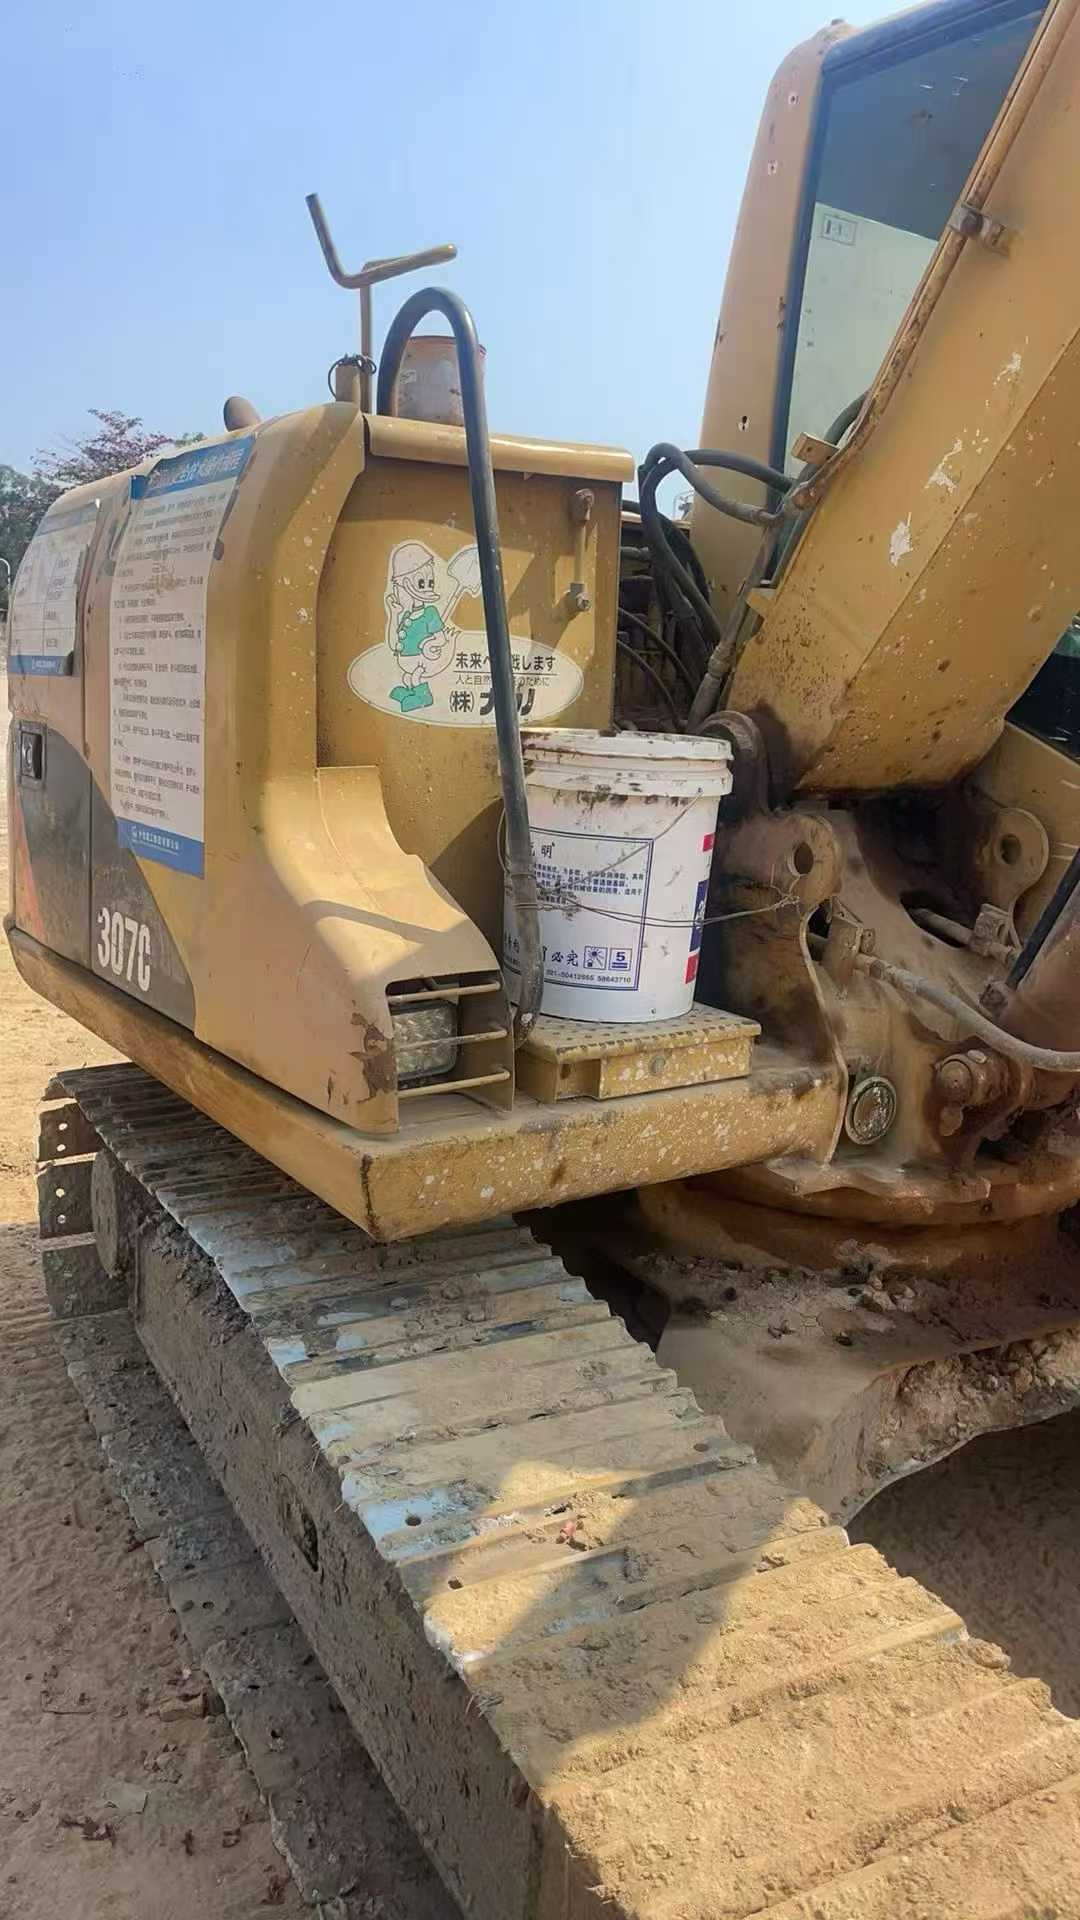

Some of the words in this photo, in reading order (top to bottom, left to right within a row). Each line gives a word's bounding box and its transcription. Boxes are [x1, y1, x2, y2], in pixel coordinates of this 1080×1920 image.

[455, 651, 556, 671] 未来へ戦します
[97, 907, 151, 992] 307C
[615, 951, 626, 961] 5
